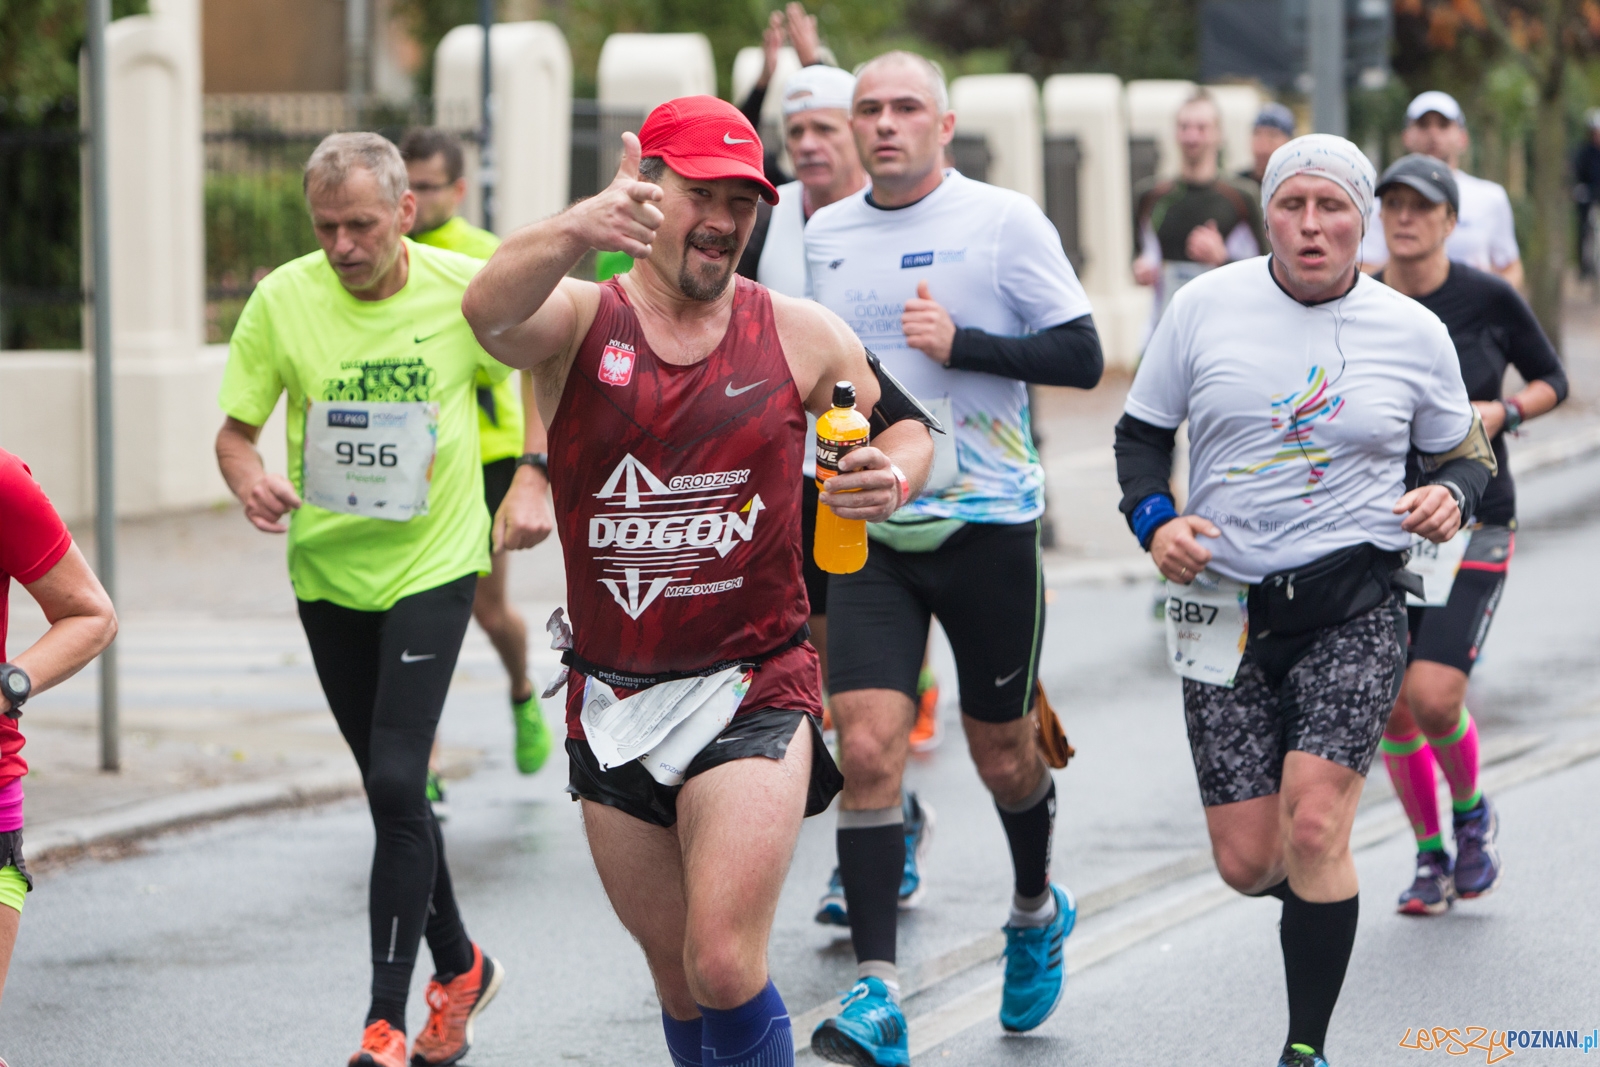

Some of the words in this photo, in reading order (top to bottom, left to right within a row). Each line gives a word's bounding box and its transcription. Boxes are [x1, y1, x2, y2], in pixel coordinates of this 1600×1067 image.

[608, 338, 635, 352] POLSKA
[336, 441, 398, 467] 956
[669, 469, 750, 490] GRODZISK
[588, 493, 766, 559] DOGON
[665, 577, 743, 598] MAZOWIECKI
[599, 670, 657, 684] performance
[605, 678, 639, 689] recovery
